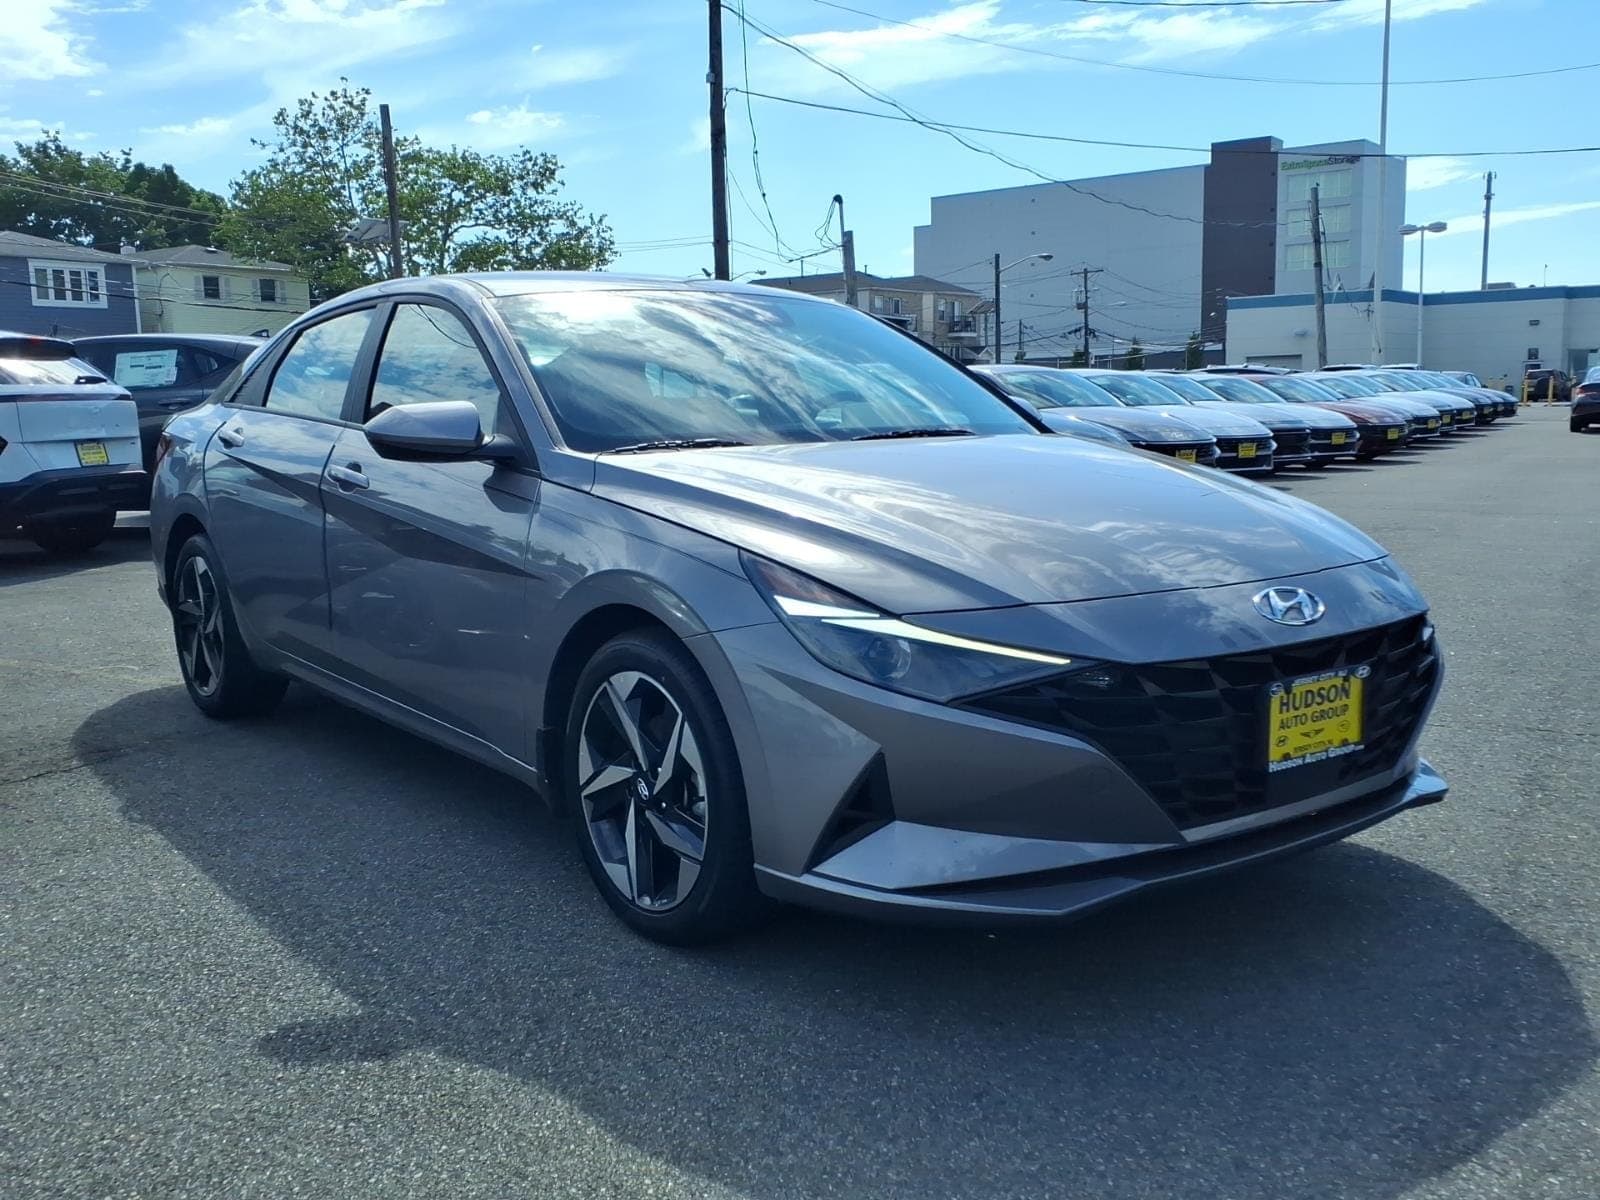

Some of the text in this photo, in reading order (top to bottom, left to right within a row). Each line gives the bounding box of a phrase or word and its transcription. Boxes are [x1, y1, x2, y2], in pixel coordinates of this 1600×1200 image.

[1278, 681, 1351, 715] HUDSON
[1278, 704, 1349, 731] AUTO GROUP
